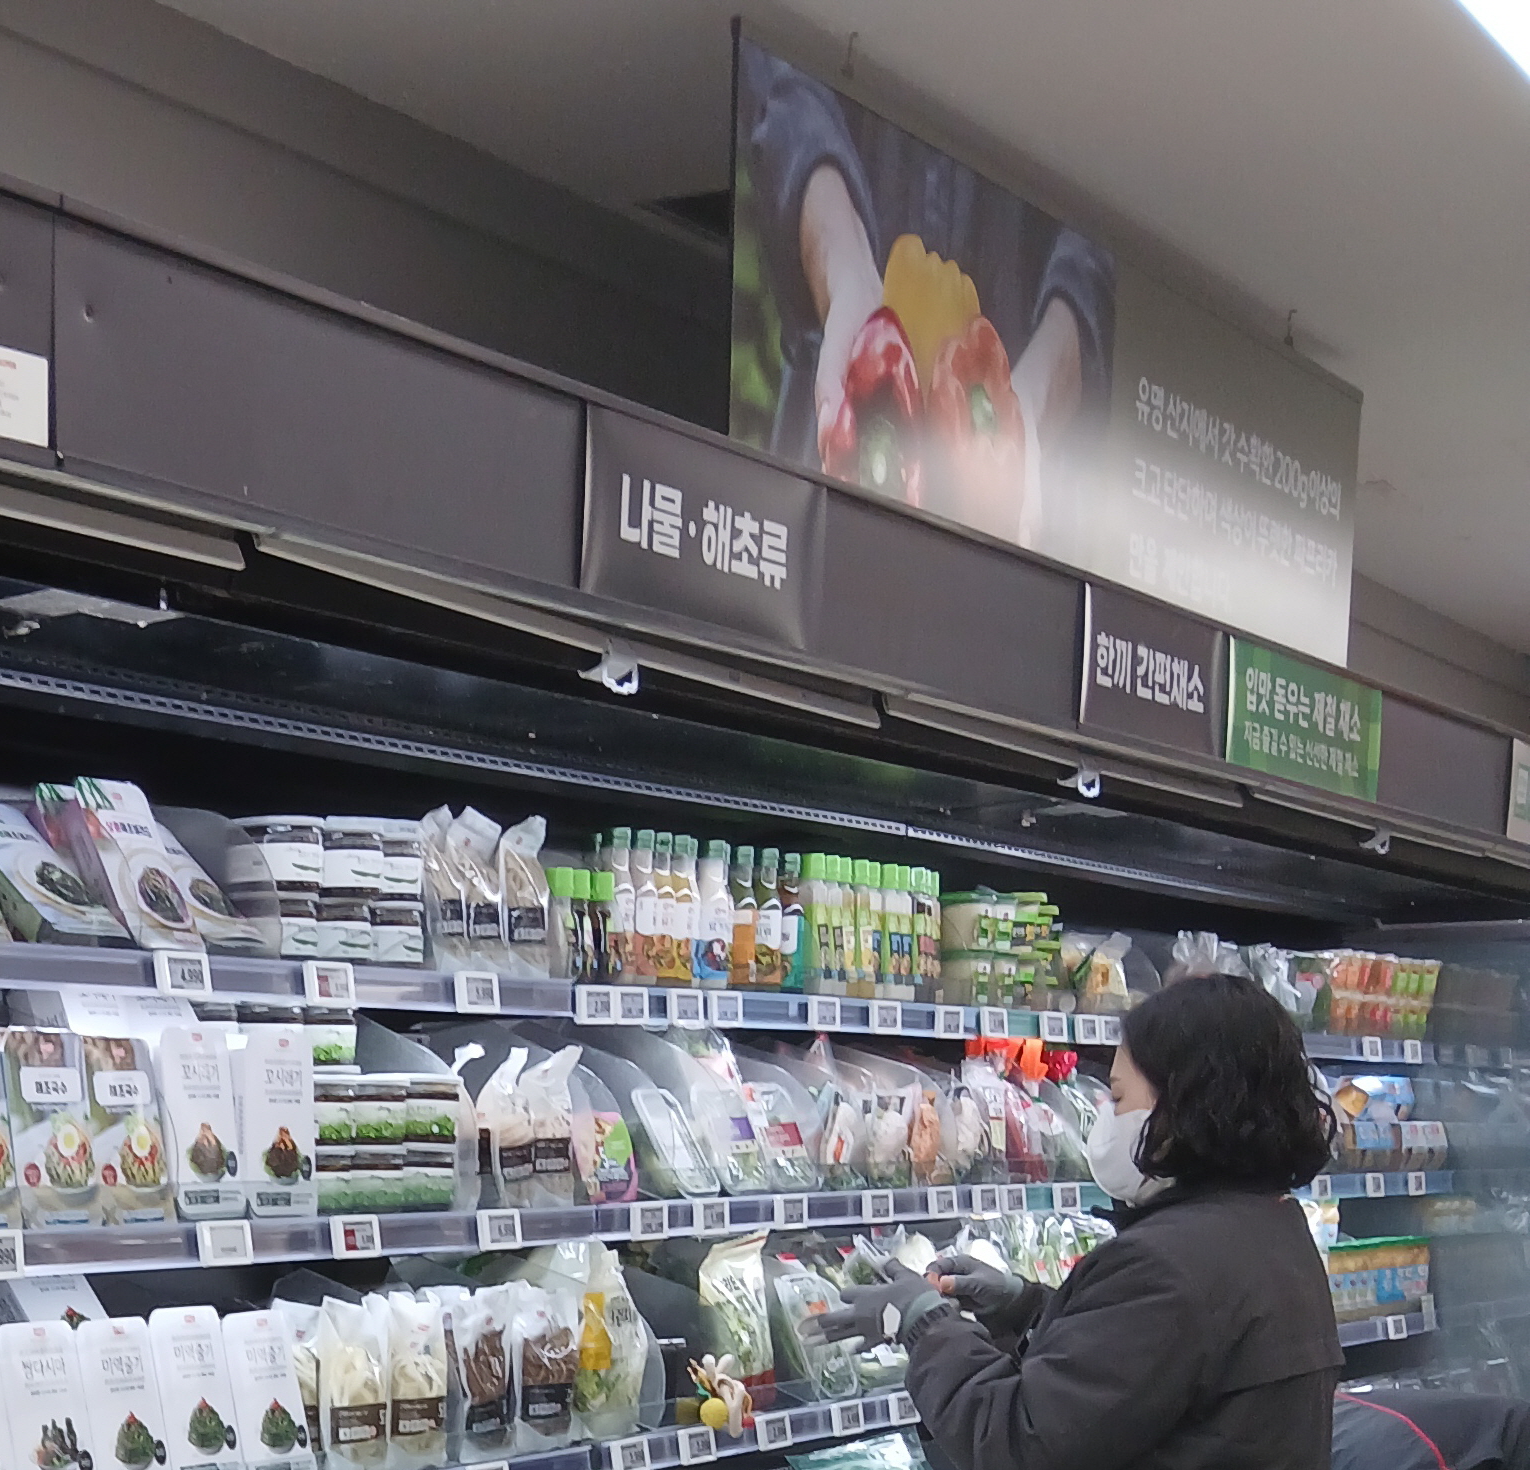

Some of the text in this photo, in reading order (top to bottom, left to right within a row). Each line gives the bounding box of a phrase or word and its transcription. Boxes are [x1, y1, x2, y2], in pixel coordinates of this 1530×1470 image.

[1134, 375, 1165, 432] 유명
[1166, 393, 1220, 461] 산지에서
[1236, 430, 1275, 487] 수확한
[1131, 456, 1162, 507] 크고
[619, 472, 788, 591] 나물·해초류
[1096, 631, 1205, 714] 한끼 간편채소
[1245, 666, 1270, 717] 입맛
[1312, 690, 1337, 737] 제철
[1337, 698, 1362, 743] 채소
[1243, 720, 1261, 752] 지금
[1278, 732, 1288, 758] 수
[1288, 735, 1305, 763] 있는
